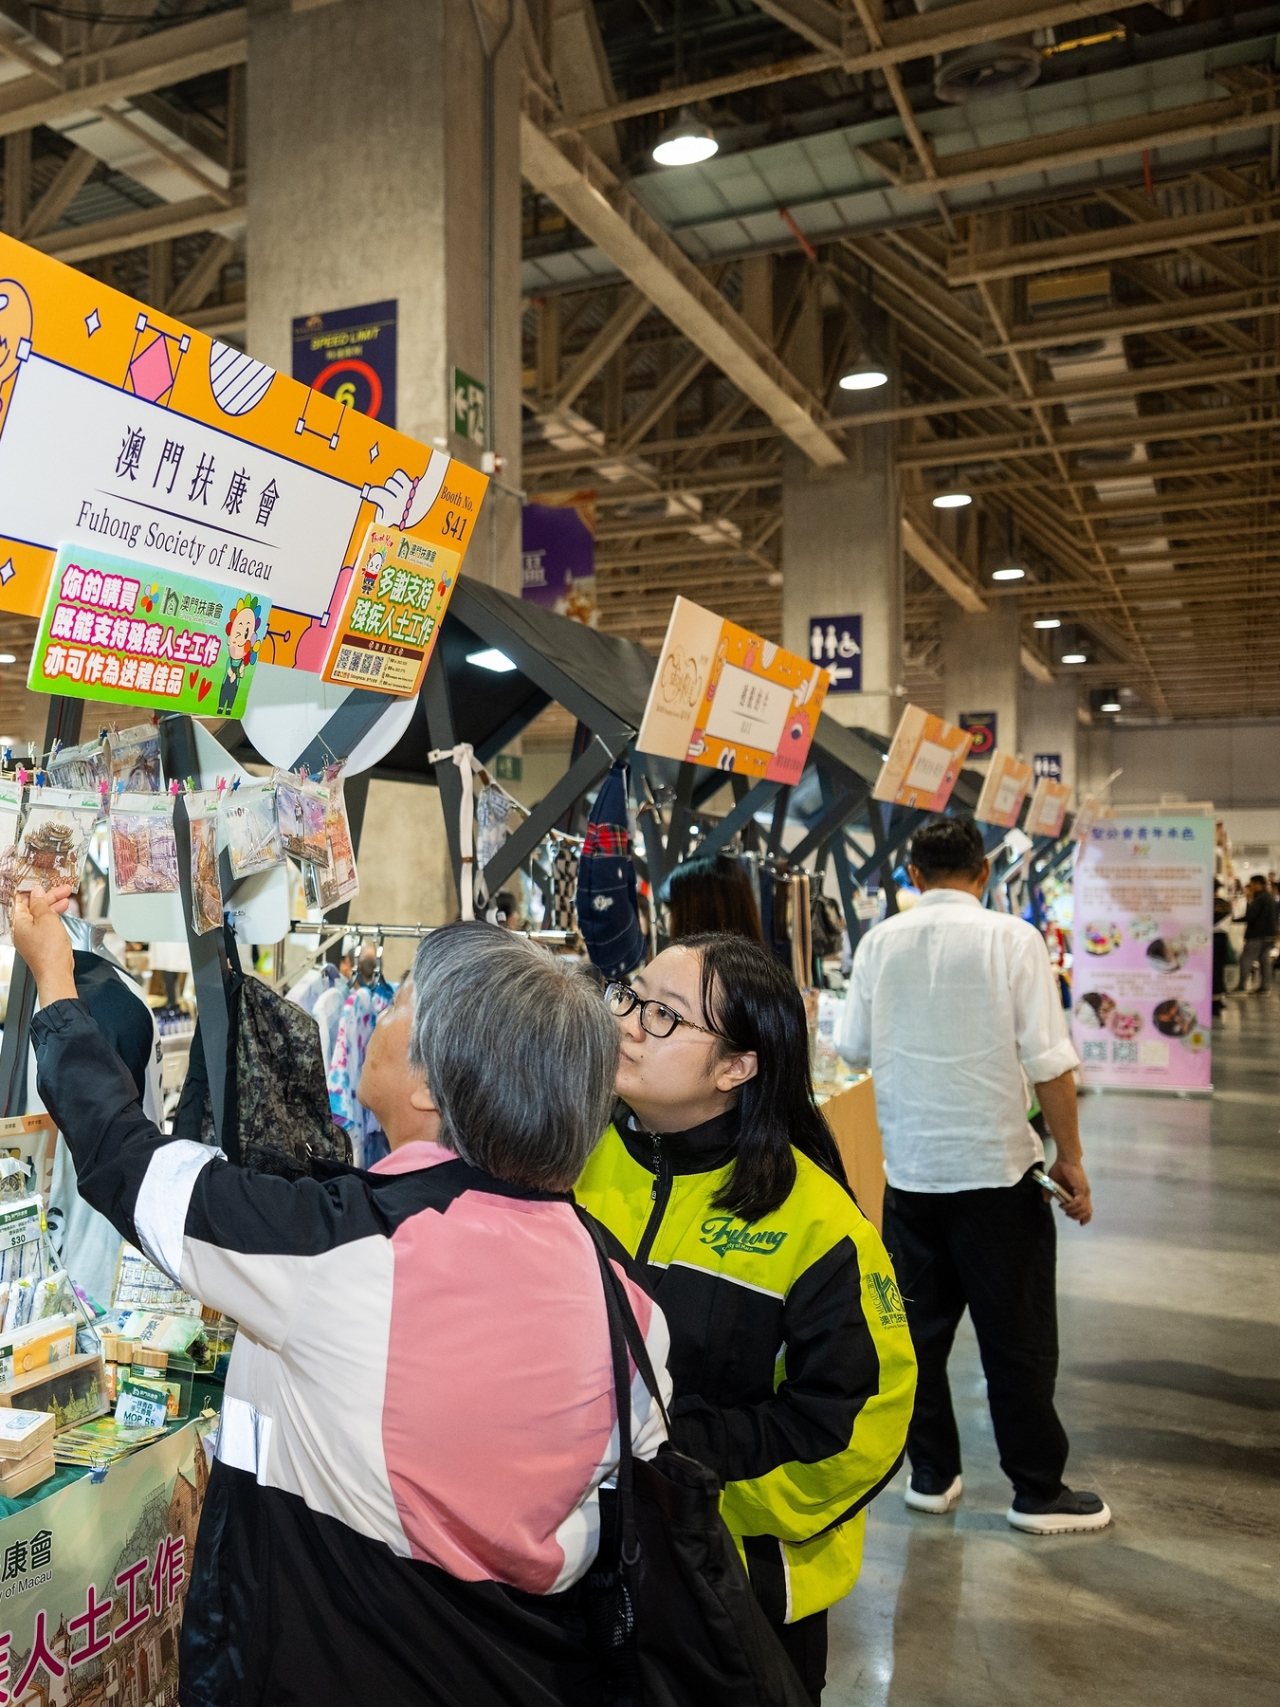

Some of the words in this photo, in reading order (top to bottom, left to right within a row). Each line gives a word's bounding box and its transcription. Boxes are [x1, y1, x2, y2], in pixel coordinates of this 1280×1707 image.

[310, 332, 348, 351] SPEED
[350, 327, 381, 345] LIMIT
[335, 382, 356, 409] 6
[115, 424, 280, 527] 澳門扶康會
[441, 486, 462, 505] Booth
[461, 496, 473, 512] No.
[76, 501, 141, 548] Fuhong
[144, 522, 205, 565] Society
[208, 544, 228, 567] of
[228, 547, 273, 581] Macau
[441, 511, 467, 541] S41
[61, 564, 140, 614] 你的購買
[377, 565, 435, 611] 多謝支持
[180, 595, 224, 619] 澳門扶康會
[350, 597, 435, 648] 殘疾人士工作
[49, 603, 221, 668] 既能支持殘疾人士工作
[43, 643, 185, 697] 亦可作為送禮佳品
[10, 1234, 26, 1245] $30
[699, 1215, 788, 1253] Fuhong
[124, 1411, 142, 1423] MOP
[145, 1418, 156, 1427] 55
[5, 1585, 17, 1599] of
[18, 1570, 53, 1594] Macau
